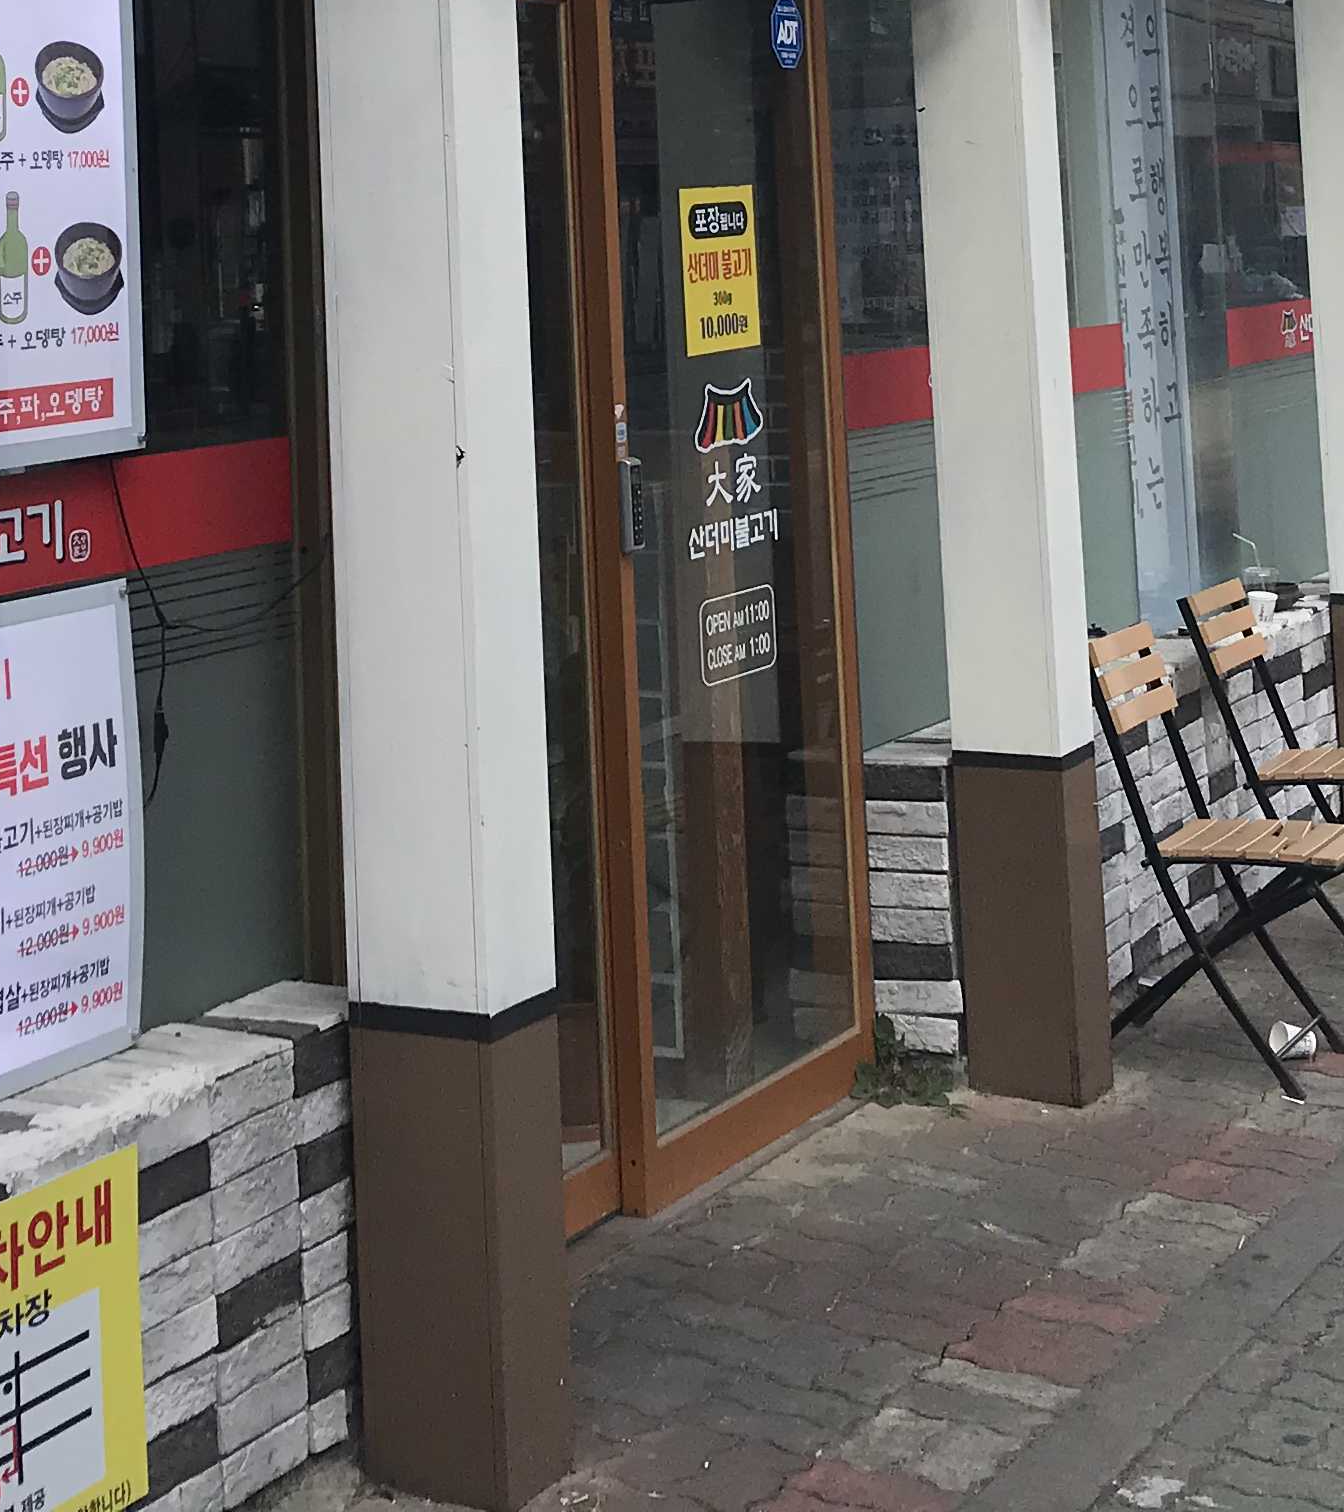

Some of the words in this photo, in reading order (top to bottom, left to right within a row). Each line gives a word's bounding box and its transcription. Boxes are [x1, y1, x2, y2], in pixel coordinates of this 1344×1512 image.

[777, 20, 798, 45] ADT
[29, 149, 65, 170] 오뎅탕
[67, 148, 110, 169] 17,000원
[694, 205, 745, 234] 포장됩니다
[721, 247, 752, 281] 불고기
[2, 291, 23, 306] 소주
[20, 326, 67, 351] 오뎅탕
[70, 321, 120, 348] 17,000원
[699, 312, 749, 340] 10,000원
[705, 453, 762, 507] 大家
[688, 508, 779, 560] 산더미불고기
[706, 609, 731, 637] OPEN
[744, 599, 770, 625] 11:00
[706, 642, 733, 671] CLOSE
[749, 632, 771, 657] 1:00
[57, 718, 119, 782] 행사
[81, 828, 124, 859] 9,900원
[81, 903, 126, 937] 9,900원
[81, 980, 124, 1014] 9,900원
